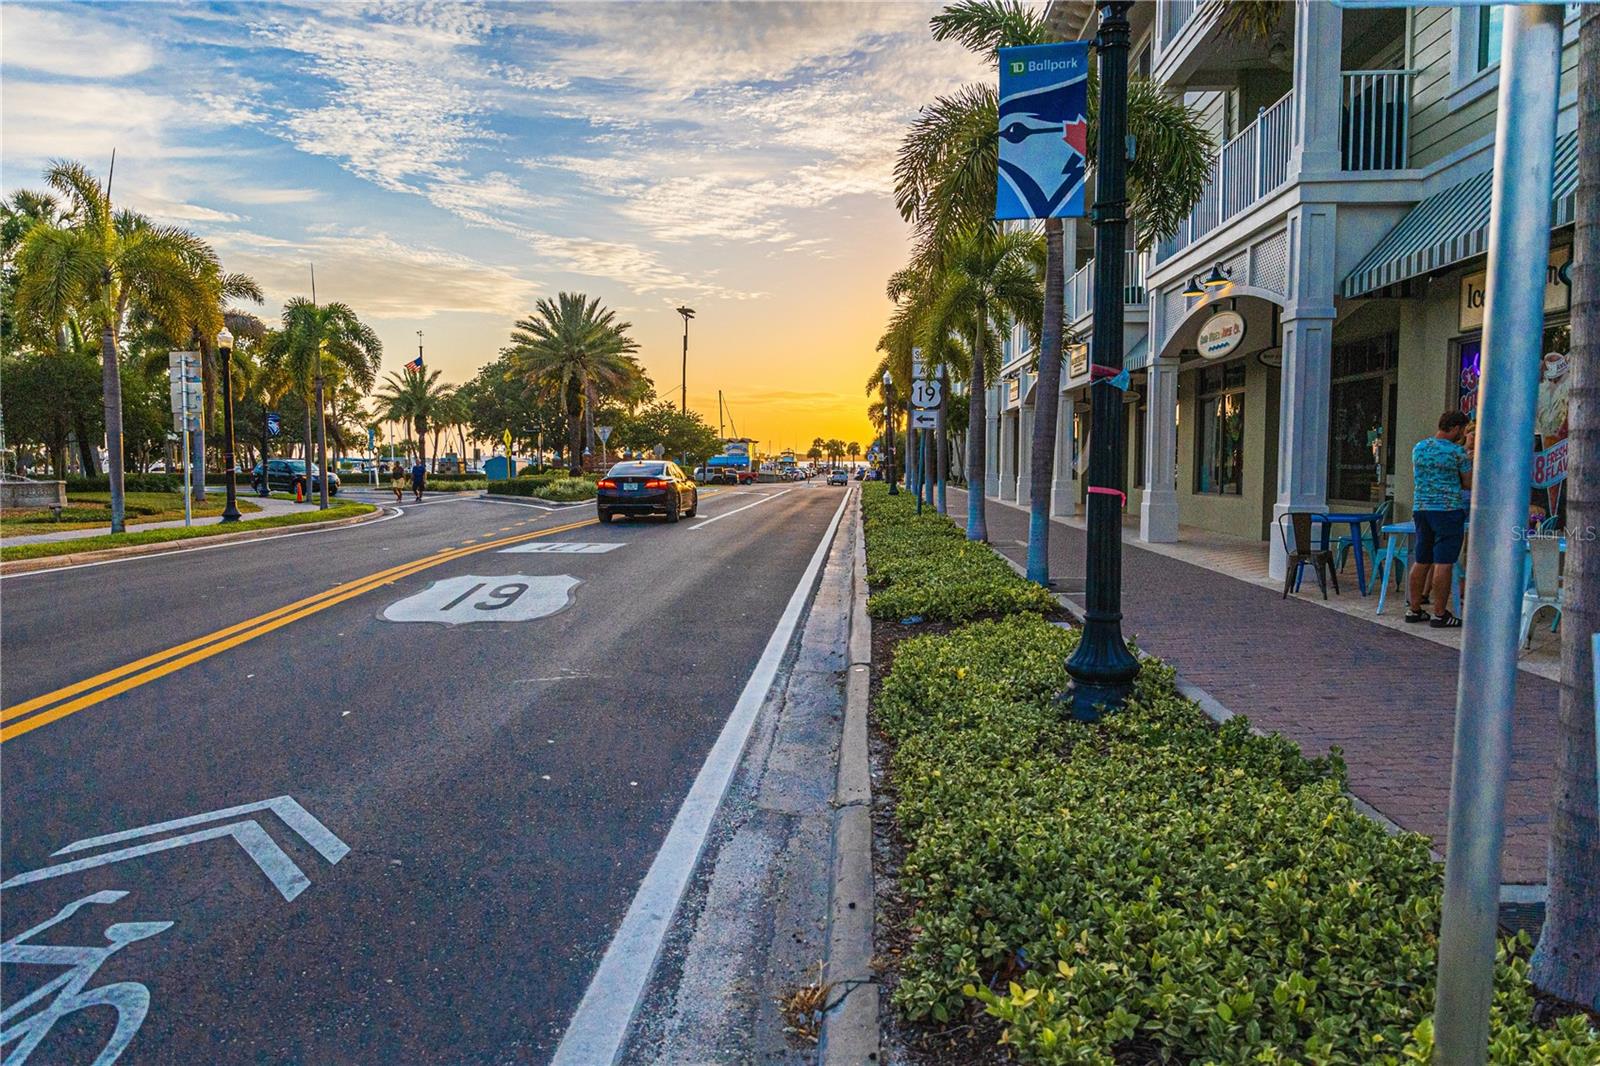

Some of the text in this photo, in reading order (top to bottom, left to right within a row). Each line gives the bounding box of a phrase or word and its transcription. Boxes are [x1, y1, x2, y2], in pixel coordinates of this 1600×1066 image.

[1011, 57, 1078, 73] TD Ballpark
[918, 386, 936, 402] 19
[439, 582, 529, 611] 19
